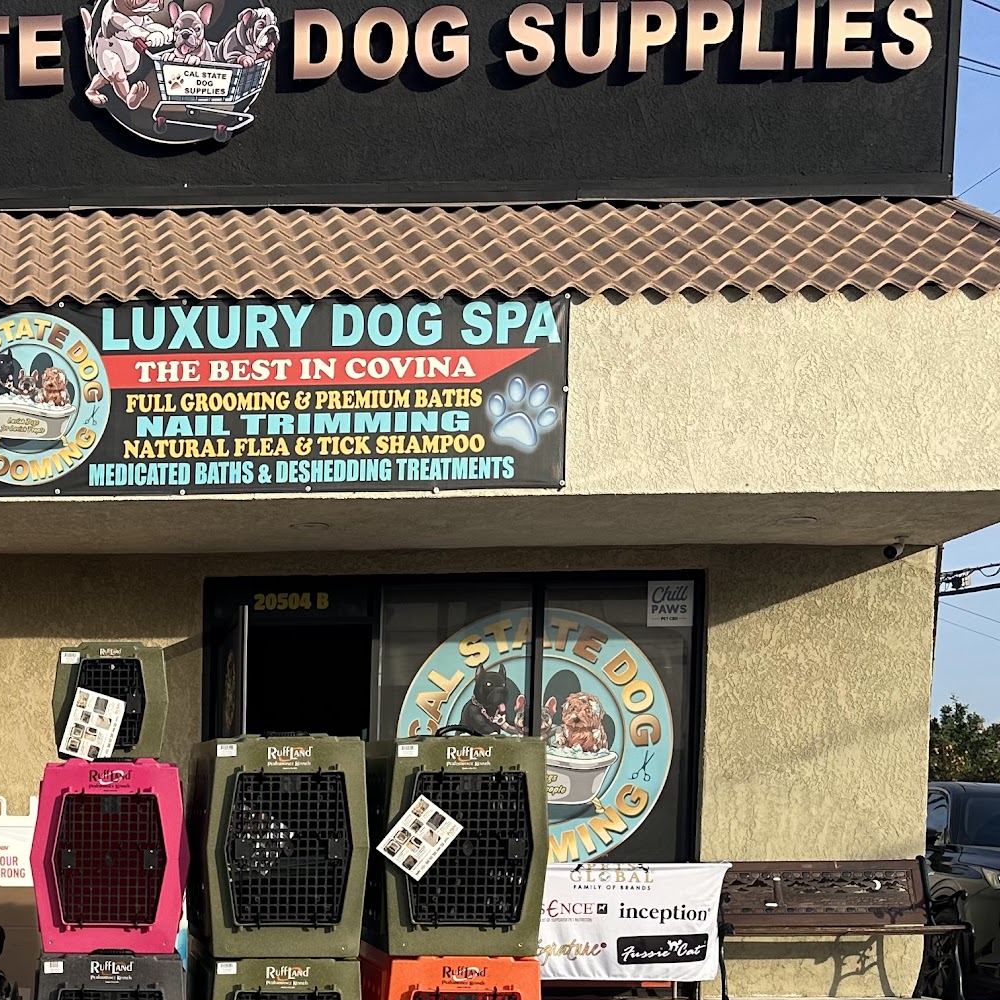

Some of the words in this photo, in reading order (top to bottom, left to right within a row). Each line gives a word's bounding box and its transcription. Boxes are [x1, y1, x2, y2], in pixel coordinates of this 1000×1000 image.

[293, 5, 470, 81] DOG
[505, 0, 933, 76] SUPPLIES
[184, 70, 200, 78] CAL
[201, 71, 227, 79] STATE
[196, 79, 214, 87] DOG
[184, 87, 226, 95] SUPPLIES
[102, 304, 314, 350] LUXURY
[331, 302, 443, 347] DOG
[461, 301, 561, 345] SPA
[66, 339, 104, 404] DOG
[135, 360, 200, 383] THE
[208, 358, 292, 382] BEST
[300, 357, 336, 380] IN
[345, 356, 477, 379] COVINA
[126, 393, 176, 413] FULL
[180, 391, 290, 412] GROOMING
[294, 391, 311, 410] &
[315, 389, 411, 410] PREMIUM
[414, 388, 483, 408] BATHS
[136, 415, 230, 437] NAIL
[240, 410, 470, 435] TRIMMING
[123, 438, 230, 459] NATURAL
[234, 437, 290, 457] FLEA
[294, 437, 313, 456] &
[317, 435, 371, 455] TICK
[376, 434, 485, 455] SHAMPOO
[88, 462, 190, 486] MEDICATED
[194, 461, 254, 485] BATHS
[257, 463, 272, 484] &
[276, 458, 392, 483] DESHEDDING
[396, 456, 515, 481] TREATMENTS
[253, 592, 312, 611] 20504
[316, 592, 329, 610] B
[652, 585, 689, 604] Chill
[651, 604, 687, 614] PAWS
[458, 616, 609, 668] STATE
[602, 649, 662, 748] DOG
[619, 902, 708, 925] inception
[621, 945, 670, 962] Fussie
[677, 942, 706, 957] Cat
